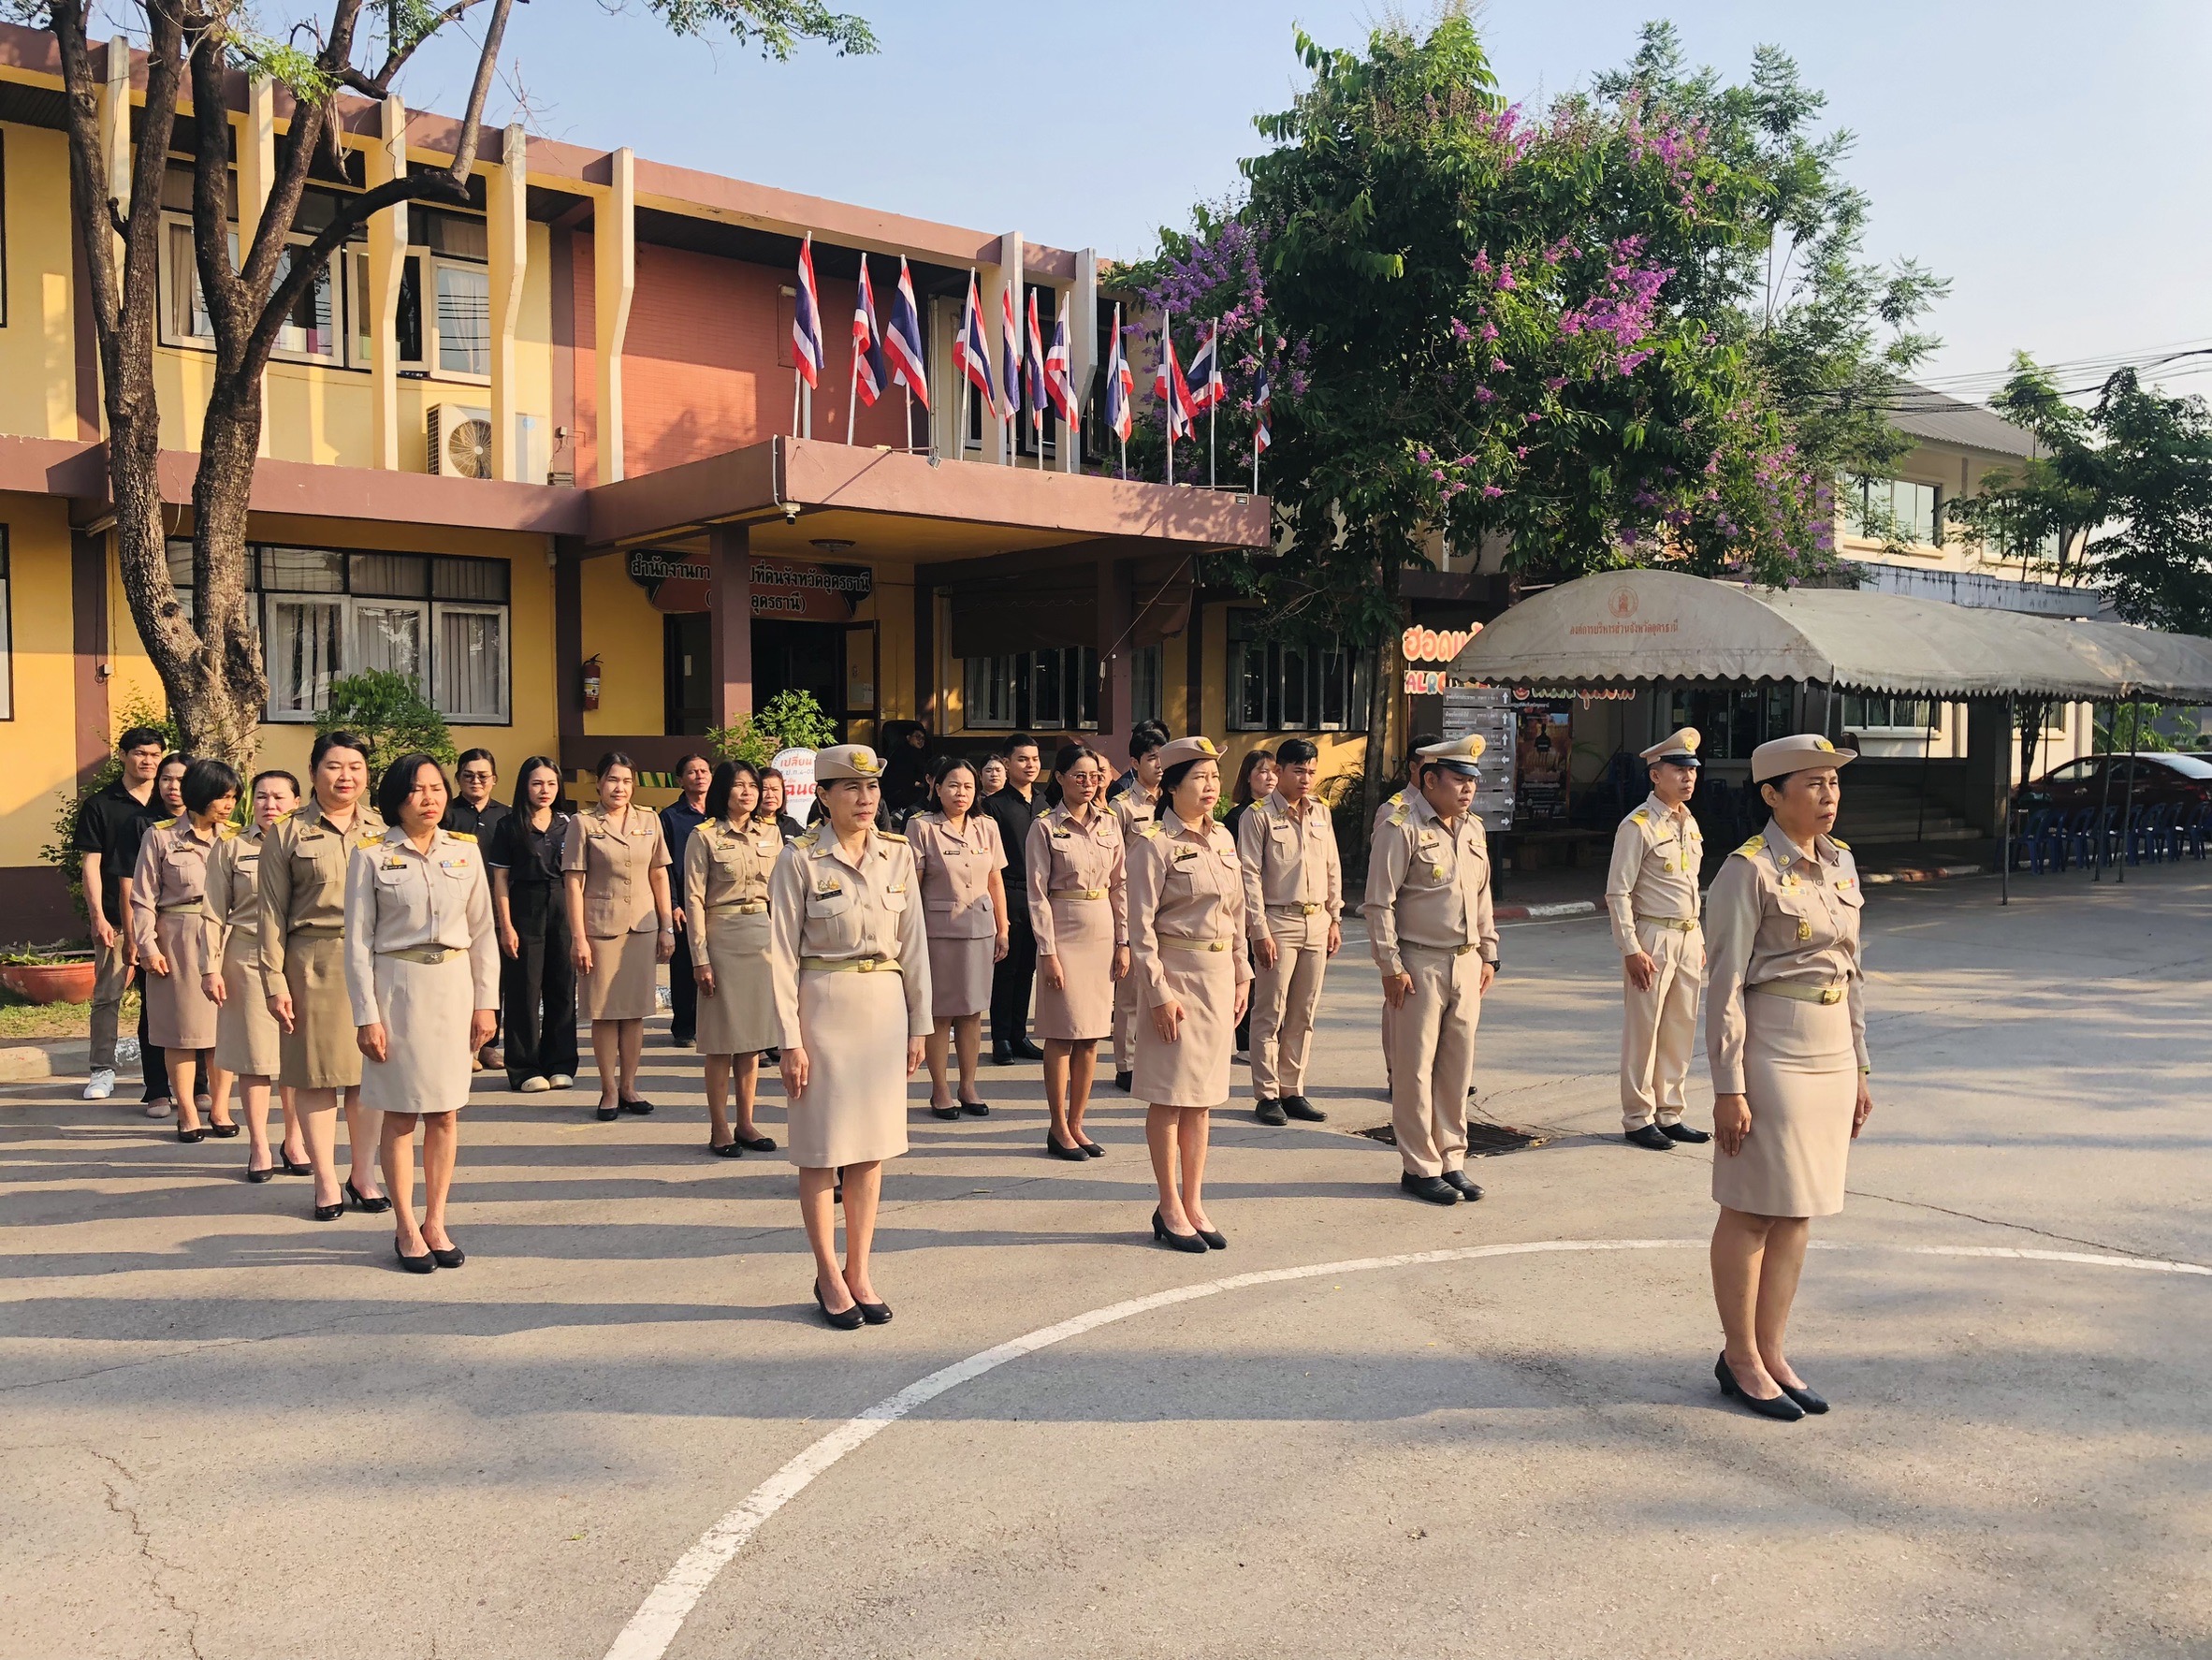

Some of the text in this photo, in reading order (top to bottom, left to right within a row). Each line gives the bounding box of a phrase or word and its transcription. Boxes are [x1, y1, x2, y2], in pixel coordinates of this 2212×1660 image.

[631, 553, 871, 594] สำนักงานกาที่ดินจังหวัดอุดรธานี
[780, 753, 812, 767] เปลี่ยน
[783, 779, 817, 795] ฉนด
